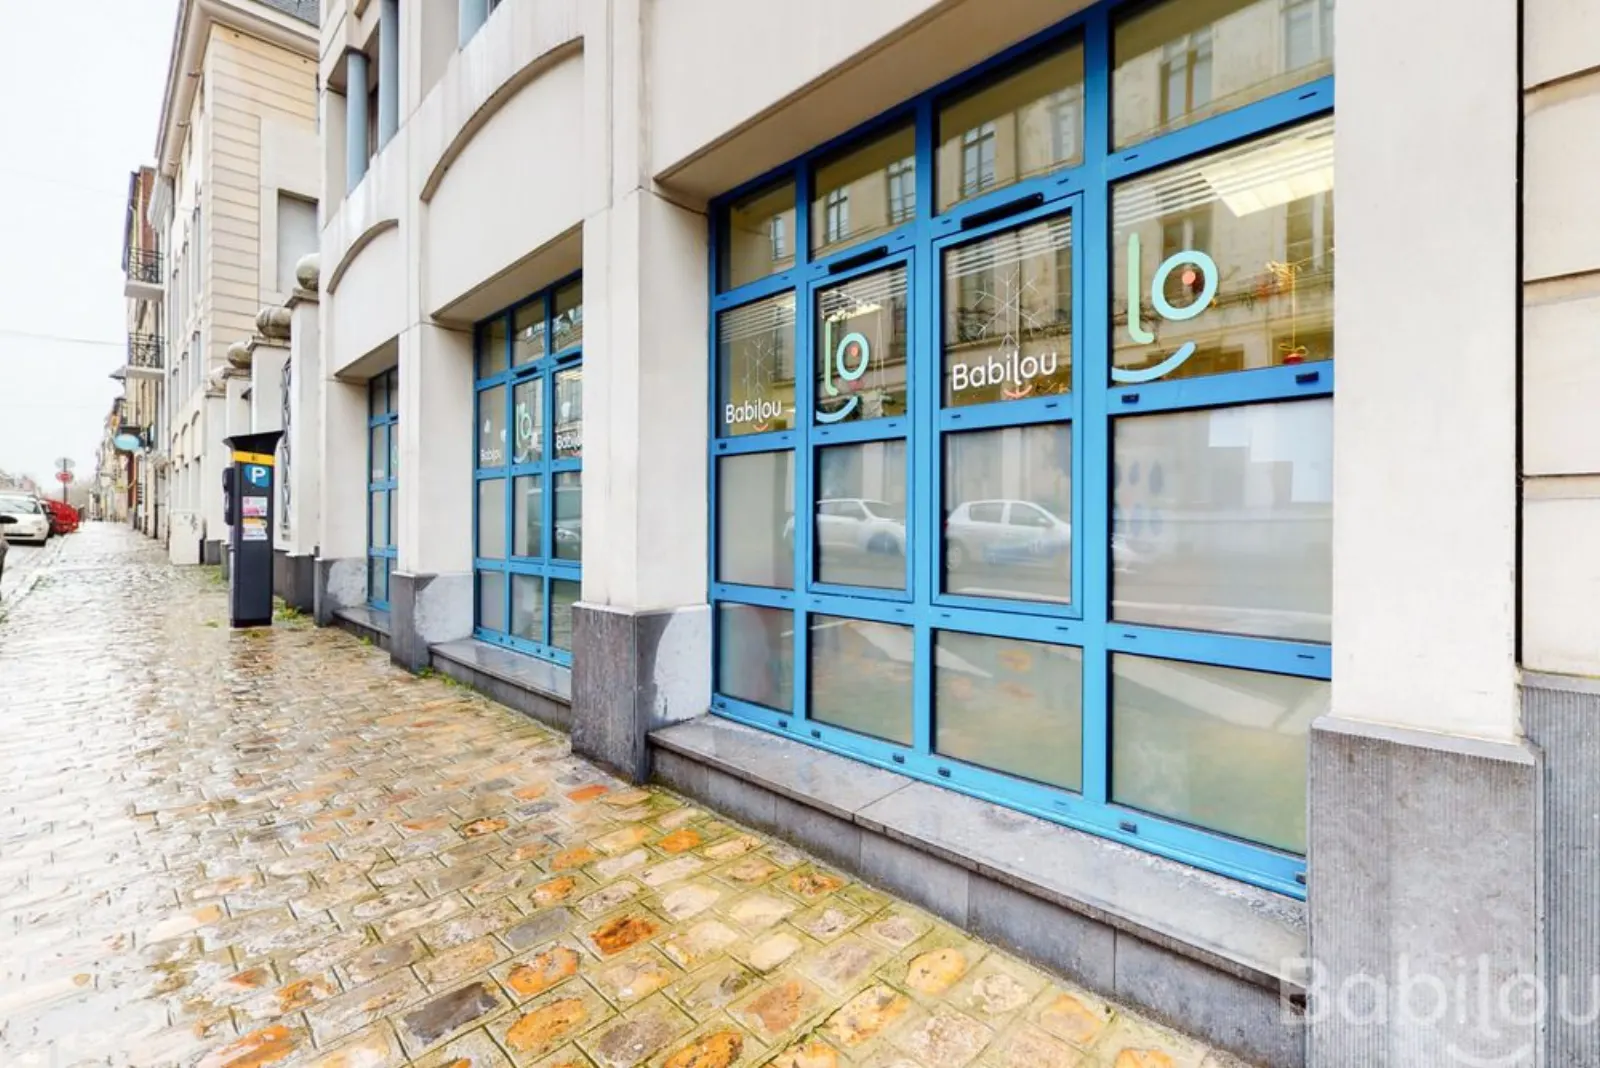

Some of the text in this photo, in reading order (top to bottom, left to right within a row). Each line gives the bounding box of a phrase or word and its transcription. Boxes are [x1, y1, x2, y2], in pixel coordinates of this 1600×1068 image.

[952, 351, 1058, 390] Babilou
[726, 398, 781, 423] Babilou
[252, 466, 266, 483] P
